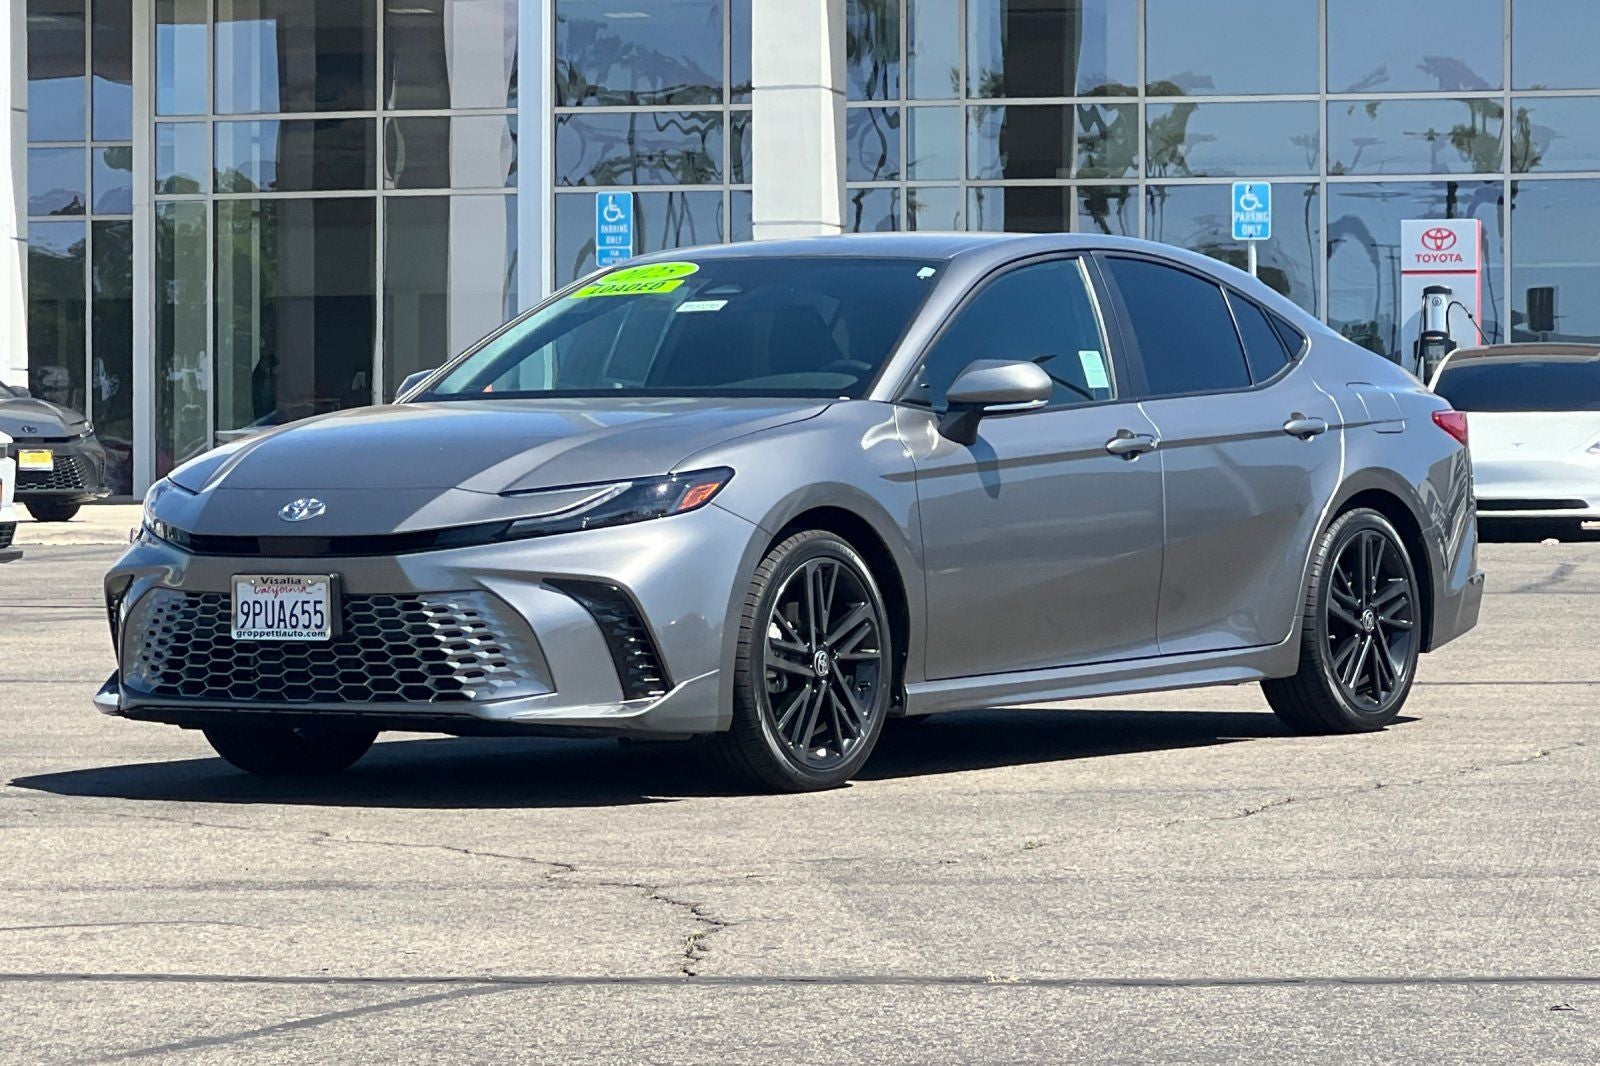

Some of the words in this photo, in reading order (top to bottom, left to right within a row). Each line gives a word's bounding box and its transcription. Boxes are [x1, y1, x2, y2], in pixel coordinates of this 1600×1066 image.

[1235, 211, 1269, 223] PARKING
[601, 224, 628, 234] PARKING
[1241, 224, 1262, 235] ONLY
[606, 235, 622, 244] ONLY
[1415, 253, 1463, 263] TOYOTA
[587, 282, 667, 295] LOADED
[260, 576, 302, 585] Visalia
[254, 586, 313, 599] California
[239, 600, 324, 629] 9PUA655
[236, 630, 326, 638] groppettiauto.com
